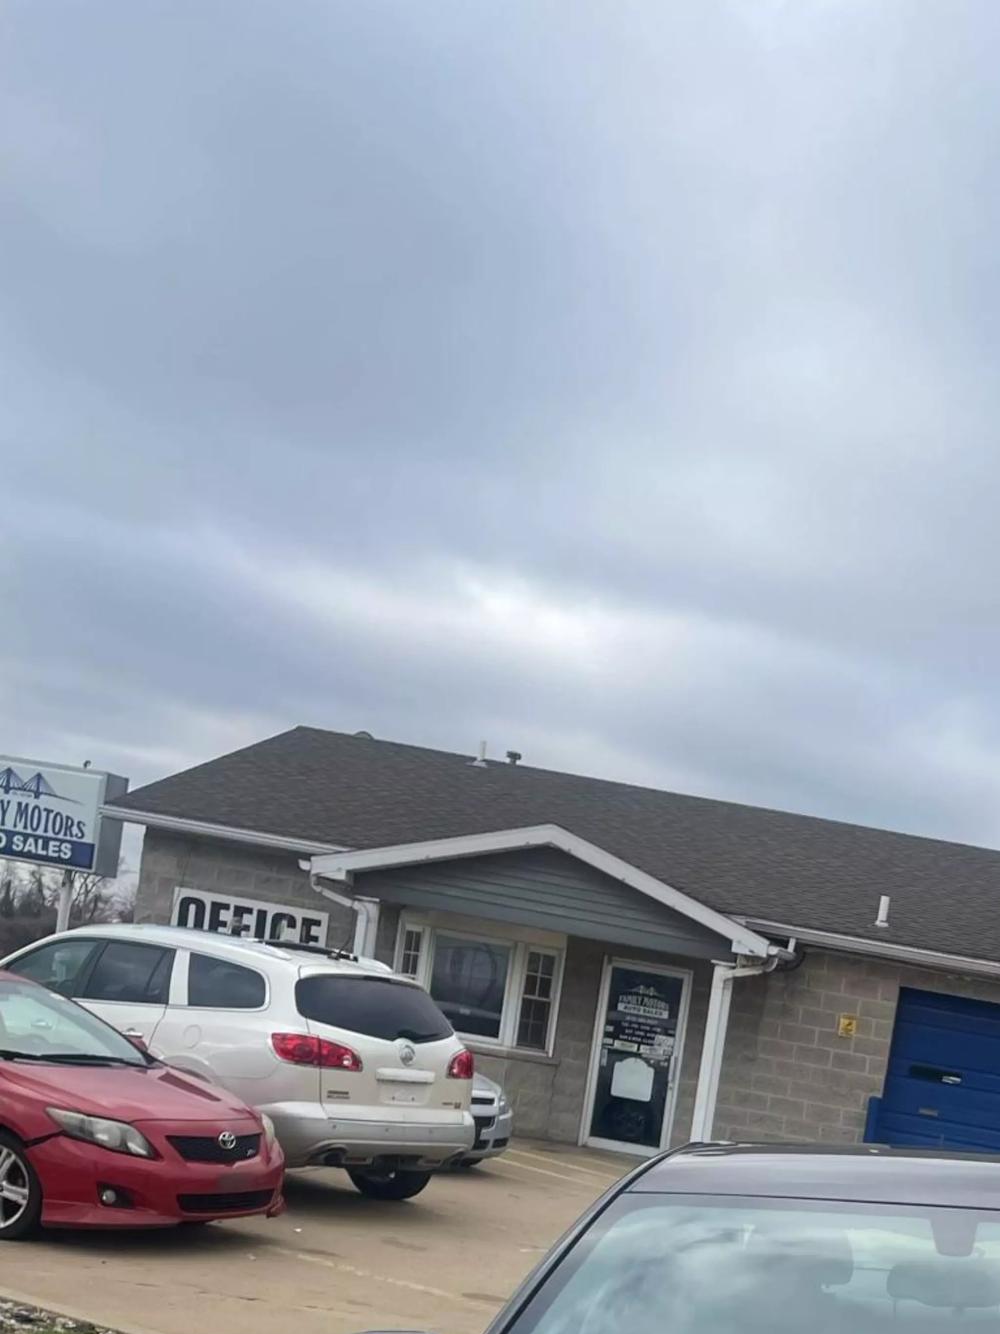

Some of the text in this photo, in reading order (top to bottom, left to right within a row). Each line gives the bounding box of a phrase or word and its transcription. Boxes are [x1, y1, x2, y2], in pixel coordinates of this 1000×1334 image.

[13, 801, 86, 839] MOTORS
[12, 835, 72, 859] SALES
[177, 896, 322, 944] OFFICE
